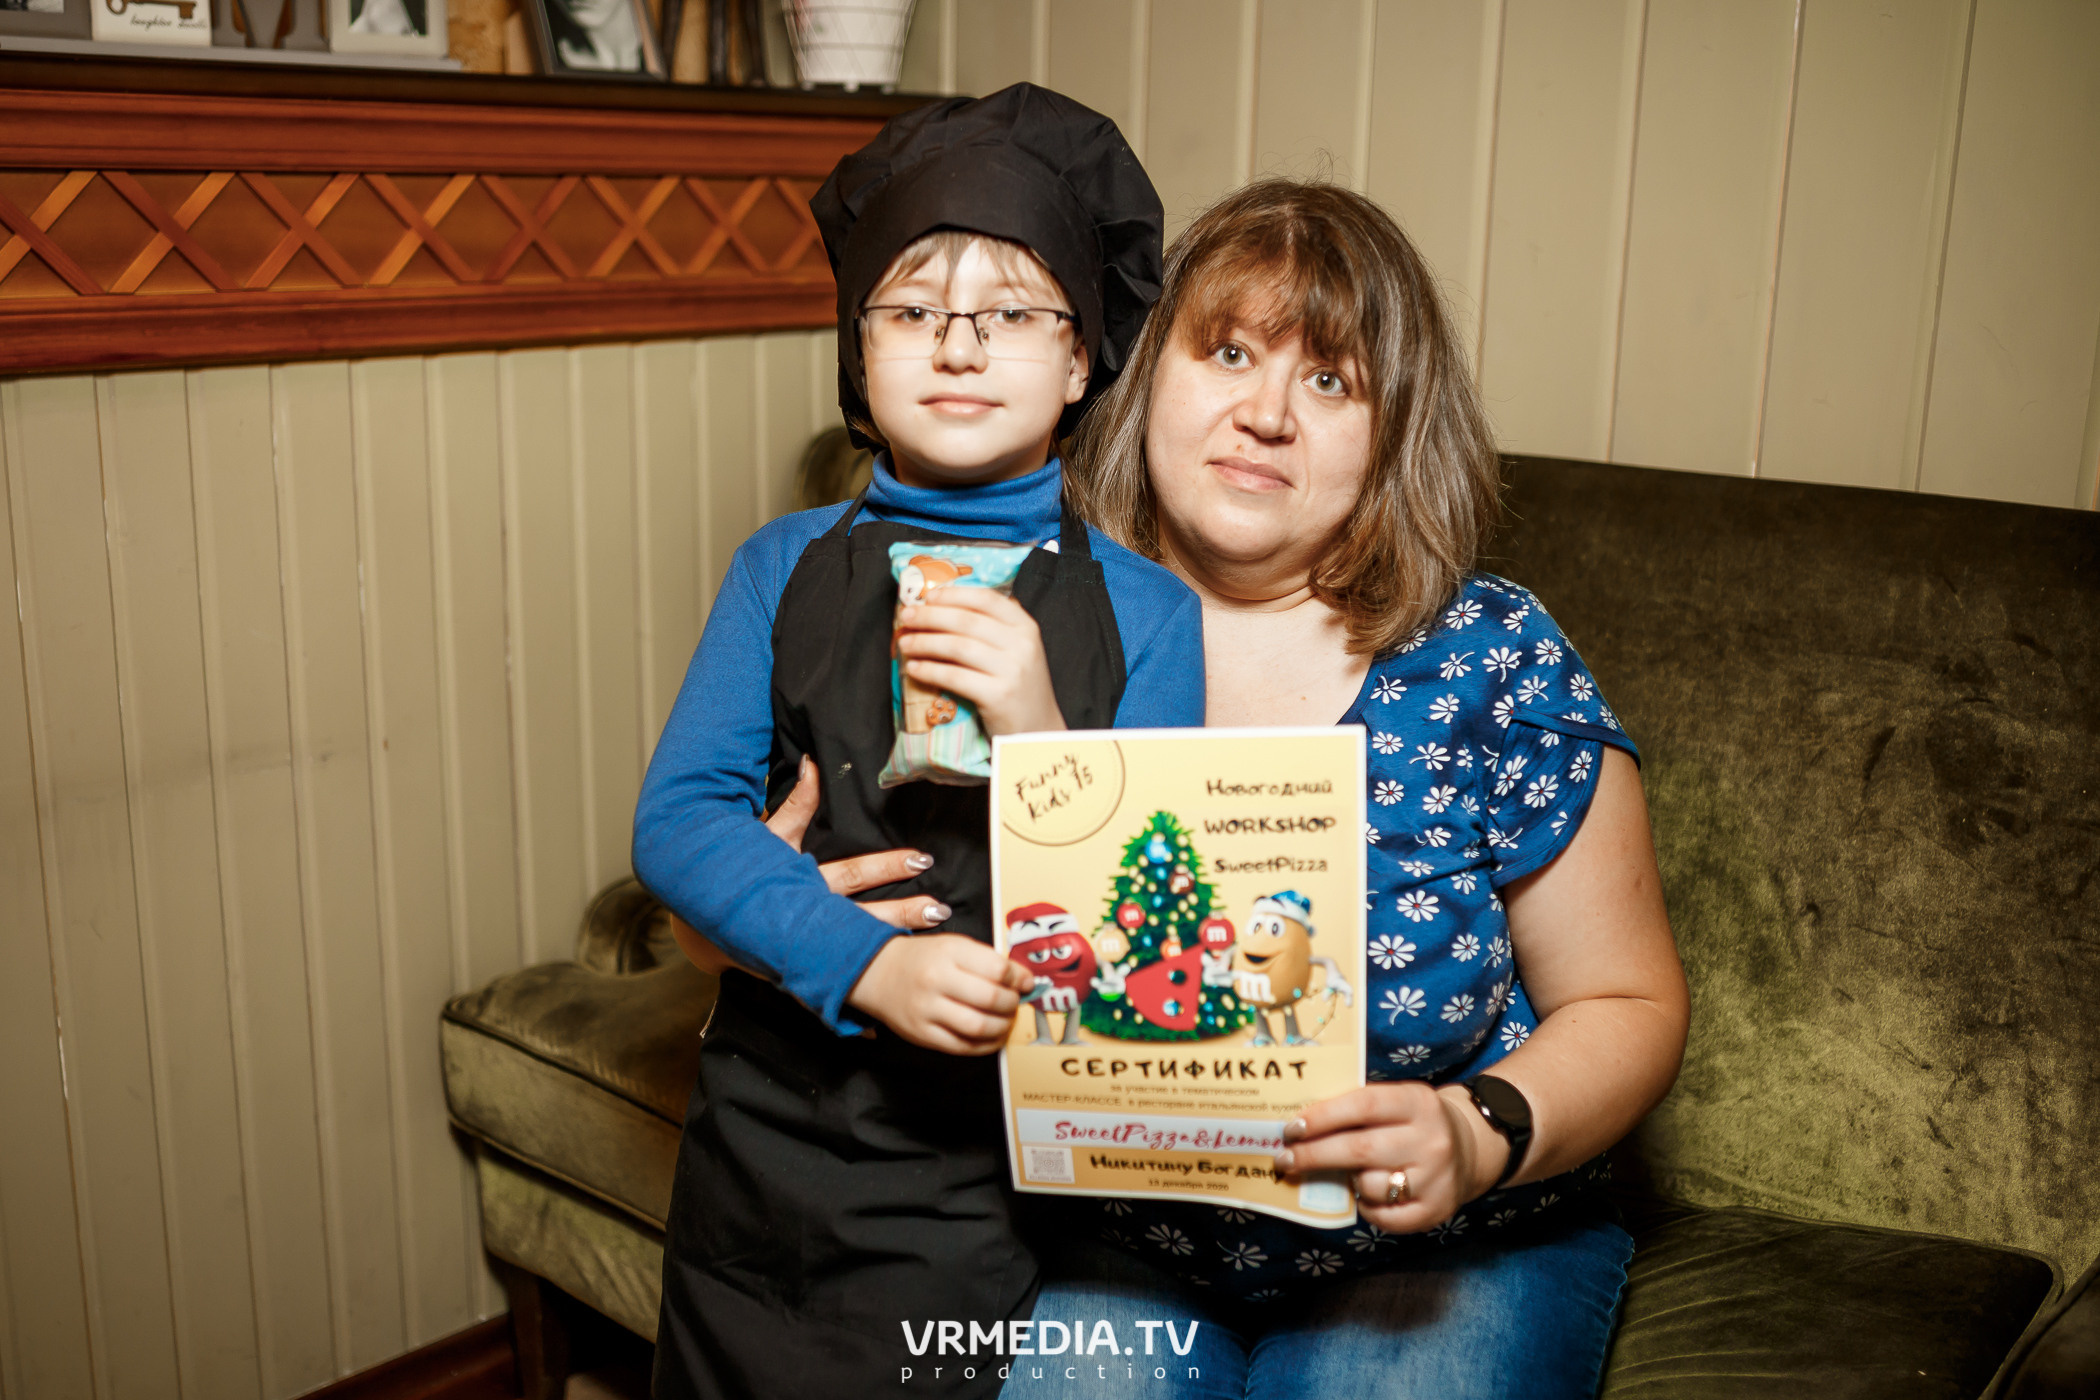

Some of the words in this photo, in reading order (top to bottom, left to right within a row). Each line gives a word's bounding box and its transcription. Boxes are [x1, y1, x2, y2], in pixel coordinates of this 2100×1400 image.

[1015, 753, 1081, 801] Funny
[1206, 778, 1334, 796] Новогодний
[1203, 816, 1337, 835] WORKSHOP
[1214, 856, 1328, 873] SweetPizza
[1060, 1058, 1308, 1080] СЕРТИФИКАТ
[1022, 1091, 1121, 1107] МАСТЕР-КЛАССЕ
[1090, 1154, 1193, 1176] Никитину
